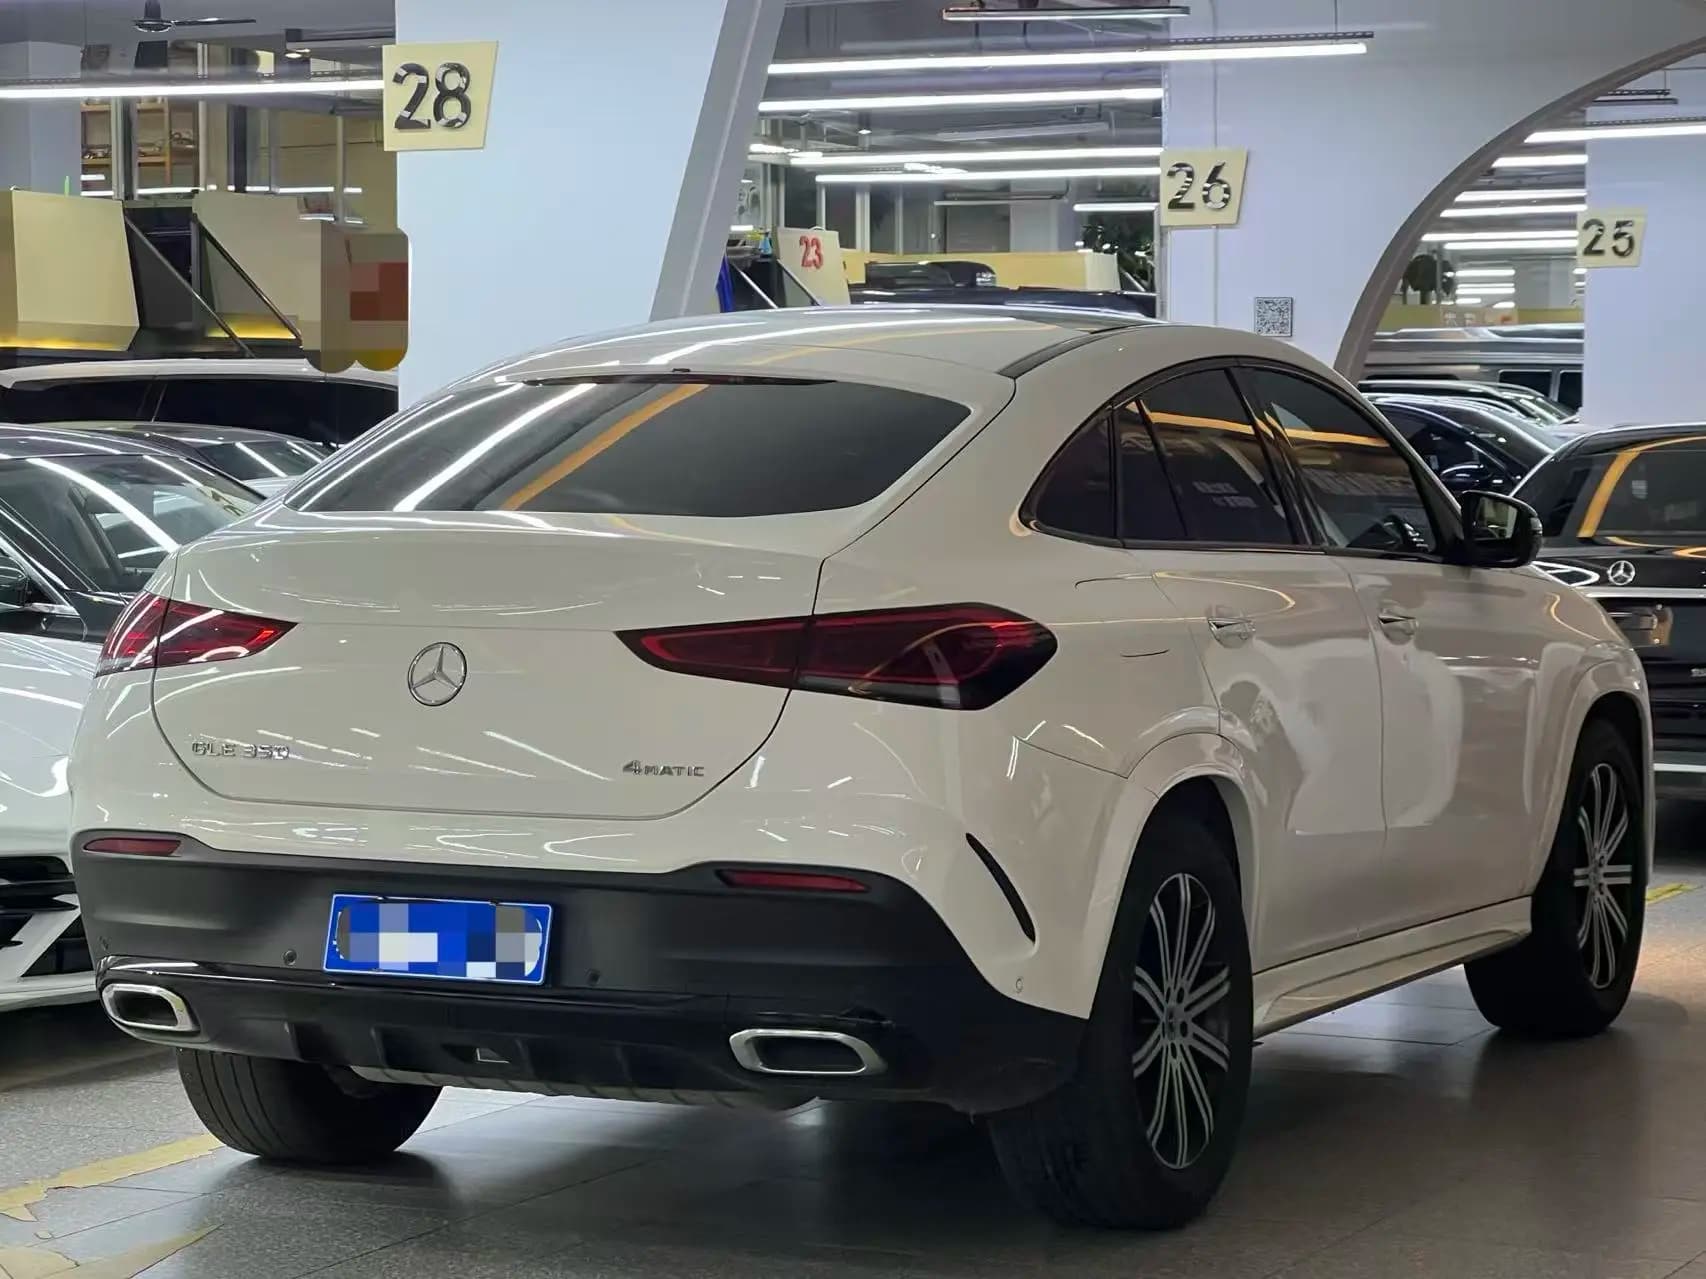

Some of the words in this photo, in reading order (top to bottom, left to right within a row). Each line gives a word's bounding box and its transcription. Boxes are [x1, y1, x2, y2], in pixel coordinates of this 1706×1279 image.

[392, 62, 471, 130] 28
[1167, 161, 1231, 210] 26
[799, 235, 823, 269] 23
[1582, 218, 1635, 257] 25
[191, 740, 236, 757] GLE
[242, 743, 290, 760] 350
[622, 759, 705, 777] 4MATIC
